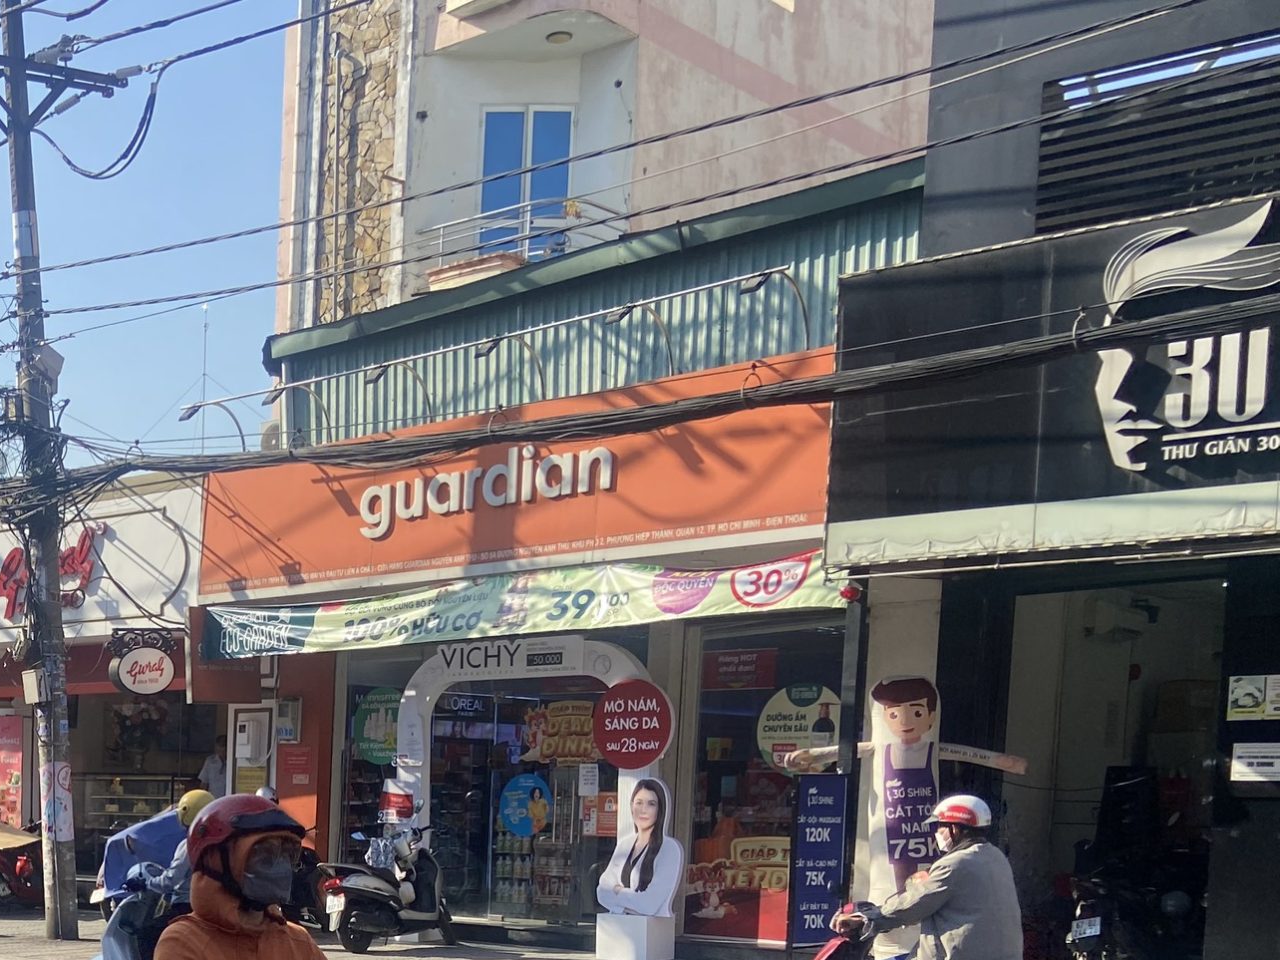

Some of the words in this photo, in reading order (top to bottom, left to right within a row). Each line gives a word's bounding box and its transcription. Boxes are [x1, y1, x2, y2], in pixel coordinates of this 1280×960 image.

[1161, 441, 1199, 462] THƯ
[1204, 435, 1250, 458] GIÃN
[359, 443, 616, 539] guardian
[742, 517, 761, 529] MINH
[676, 577, 715, 592] QUYỀN
[742, 567, 799, 599] 30%
[545, 588, 597, 622] 39
[343, 615, 410, 643] 100%
[411, 611, 449, 637] HỮU
[451, 609, 483, 632] CƠ
[220, 623, 291, 655] ECO-GARDEN
[440, 643, 523, 670] VICHY
[740, 653, 758, 662] HOT
[604, 697, 625, 714] MỜ
[627, 696, 661, 714] NÁM,
[548, 716, 593, 736] DEAL
[604, 712, 639, 731] SÁNG
[642, 716, 660, 730] DA
[762, 723, 793, 733] CHUYÊN
[793, 723, 809, 733] SÂU
[606, 742, 620, 752] SAU
[620, 737, 637, 753] 28
[638, 738, 660, 751] NGÀY
[907, 786, 933, 798] SHINE
[805, 827, 831, 843] 120K
[901, 822, 931, 835] NAM
[739, 844, 778, 862] GIÁP
[805, 870, 825, 886] 75K
[803, 914, 825, 930] 70K
